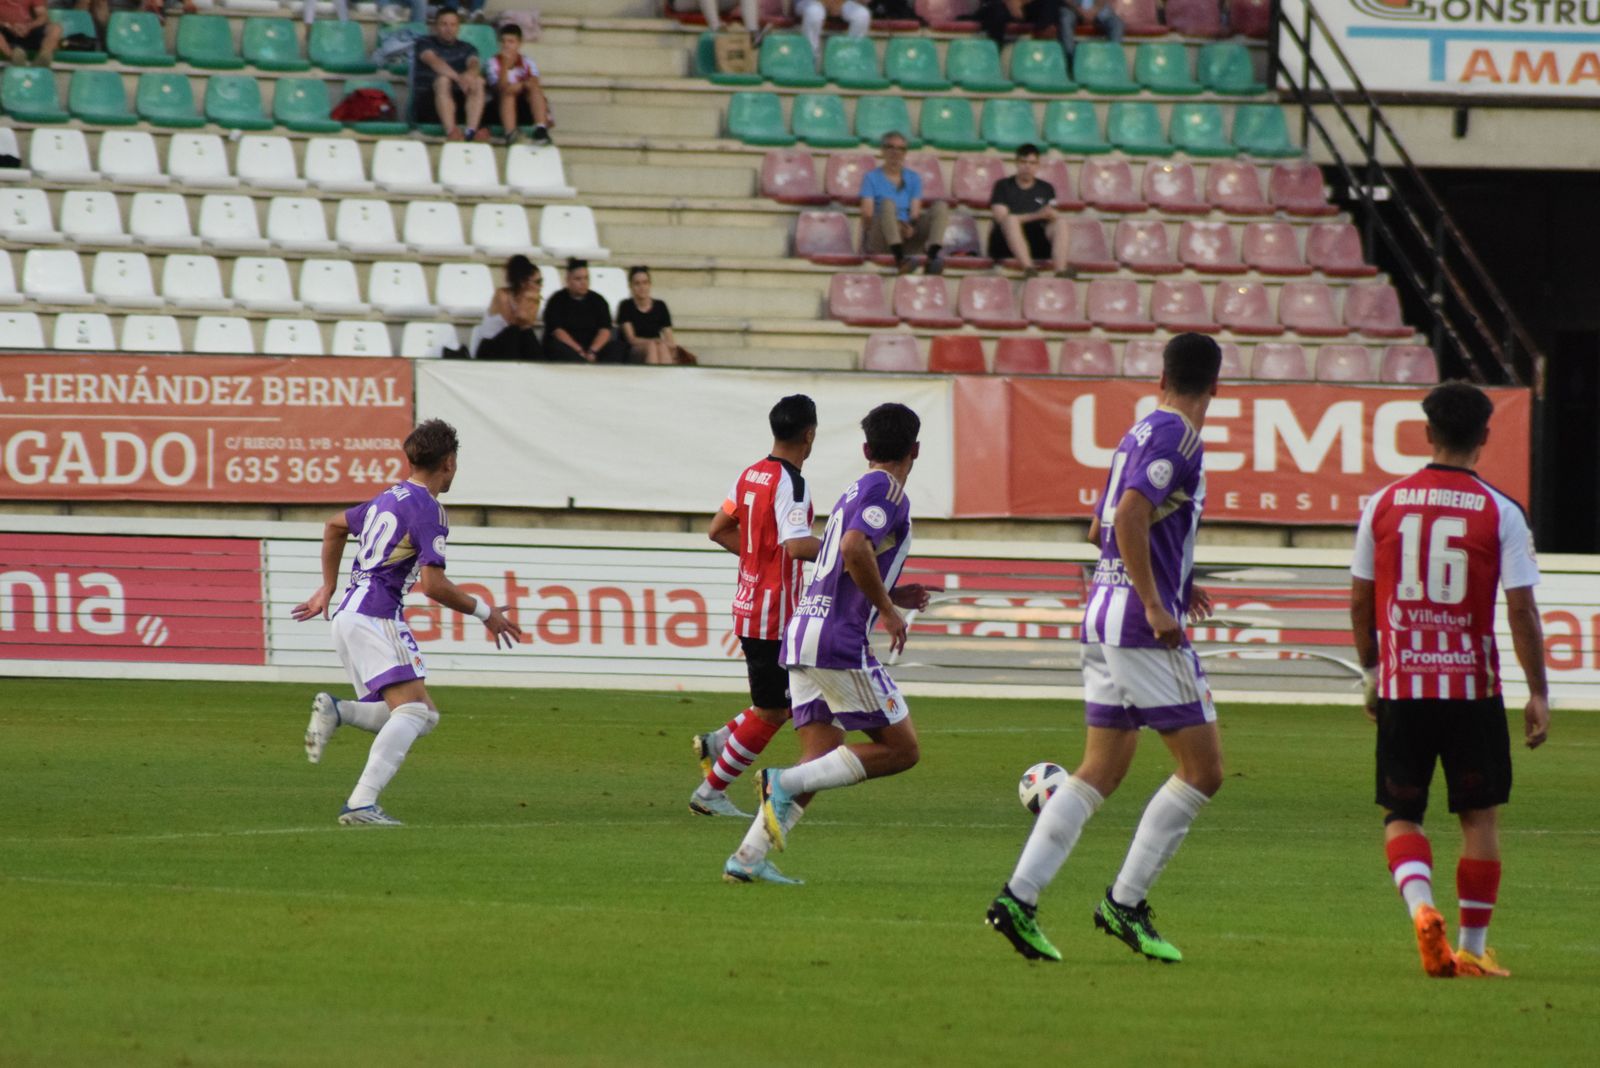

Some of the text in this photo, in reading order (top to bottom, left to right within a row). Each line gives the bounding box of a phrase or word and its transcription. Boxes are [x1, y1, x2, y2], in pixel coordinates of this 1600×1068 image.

[1347, 27, 1600, 85] TAMA
[24, 366, 253, 405] HERNÁNDEZ
[261, 375, 405, 407] BERNAL
[0, 430, 198, 486] GADO
[225, 437, 241, 450] C/
[244, 437, 286, 450] RIEGO
[343, 438, 403, 450] ZAMORA
[225, 455, 403, 484] 635 365 442
[1427, 489, 1486, 511] RIBEIRO
[1397, 513, 1469, 605] 16
[403, 570, 709, 648] antania
[1407, 608, 1472, 627] Villafuel
[1401, 649, 1477, 665] Pronatal
